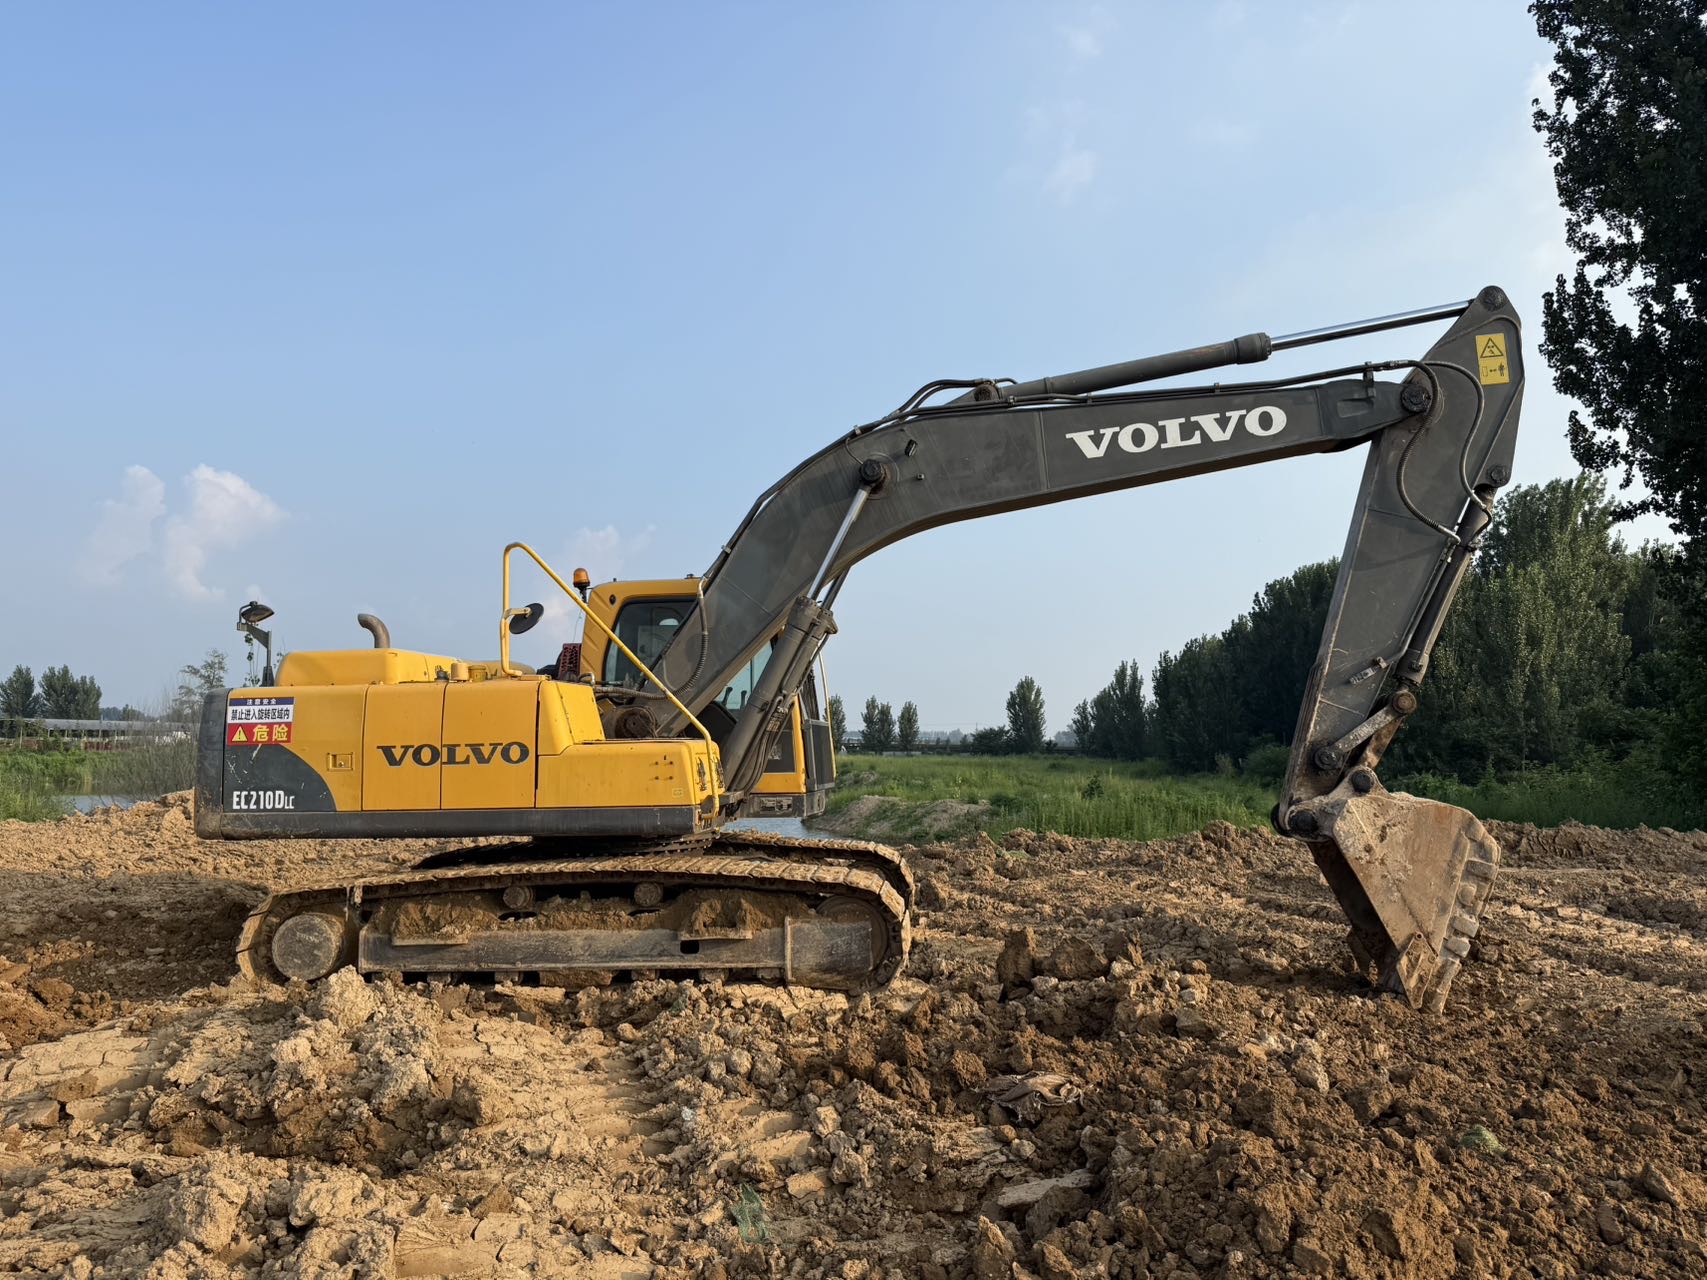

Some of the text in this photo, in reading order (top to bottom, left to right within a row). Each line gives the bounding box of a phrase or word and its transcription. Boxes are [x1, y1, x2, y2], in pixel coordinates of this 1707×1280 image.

[1065, 405, 1287, 459] VOLVO
[231, 707, 290, 720] 禁止进入旋转区域内
[252, 724, 289, 742] 危险
[376, 741, 530, 767] VOLVO
